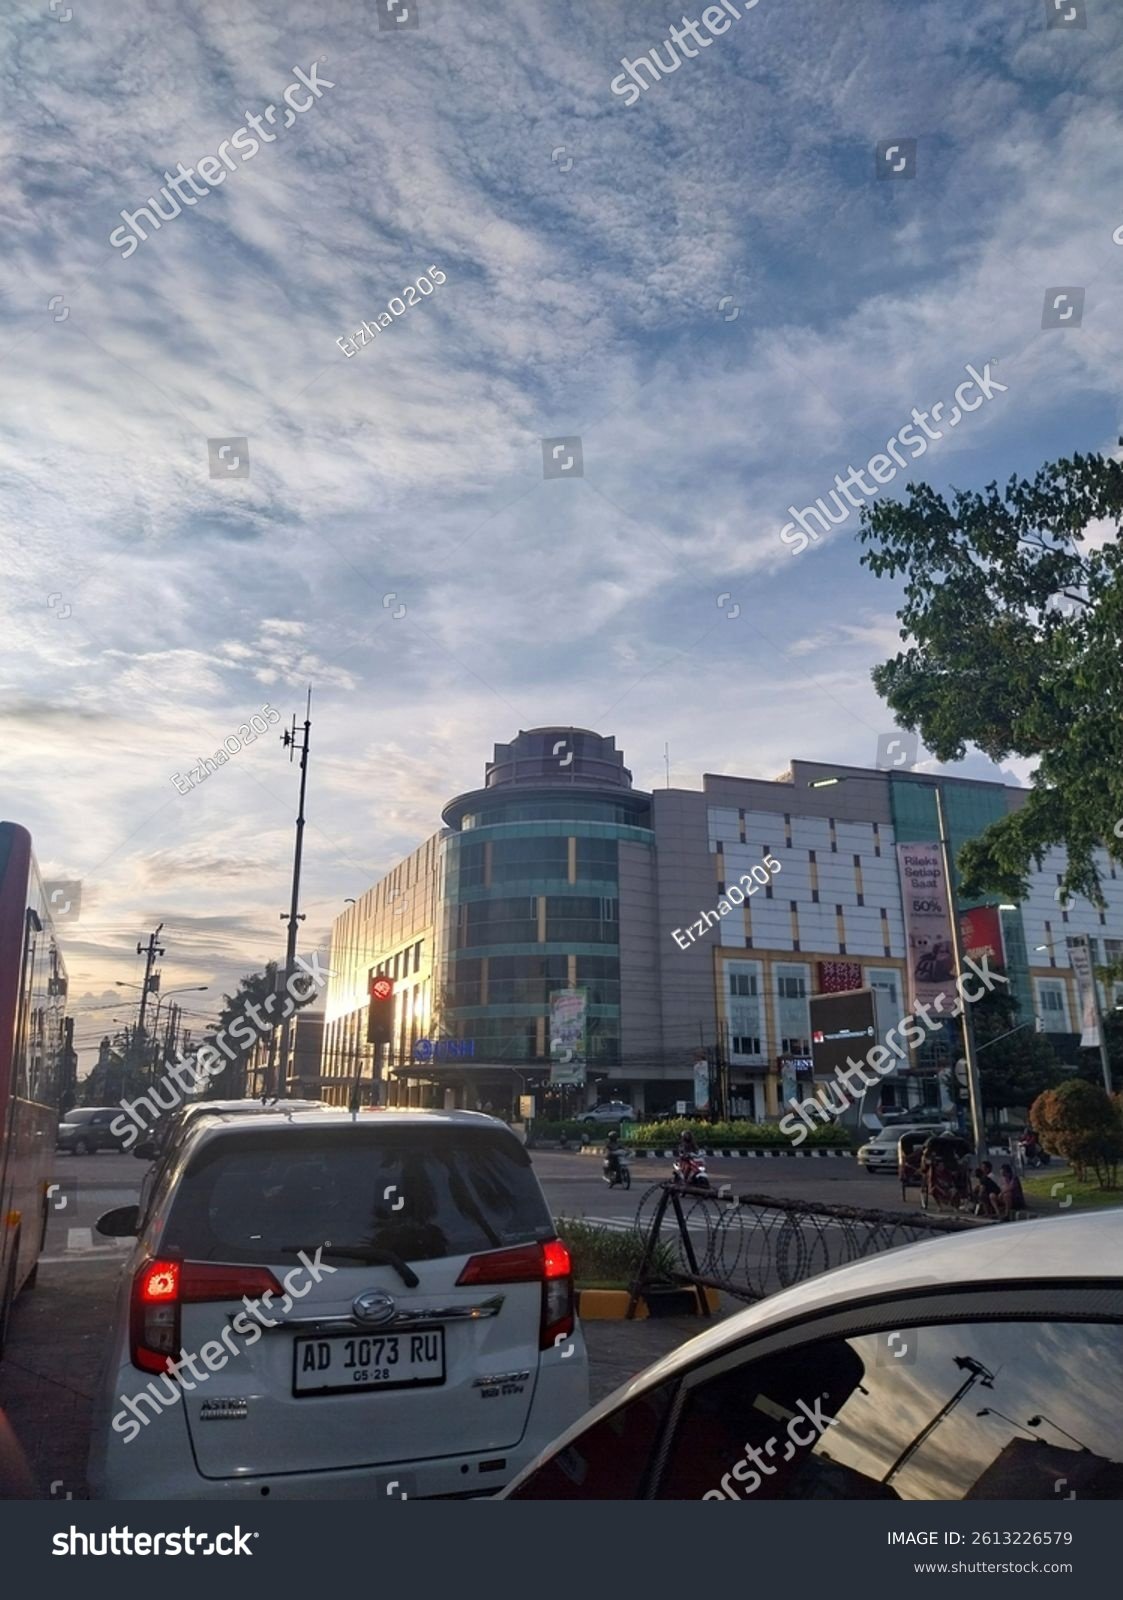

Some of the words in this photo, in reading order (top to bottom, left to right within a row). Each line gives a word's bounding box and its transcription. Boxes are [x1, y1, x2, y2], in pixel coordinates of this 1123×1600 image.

[904, 856, 938, 866] Rileks
[904, 867, 941, 878] Setiap
[911, 879, 938, 888] Saat
[913, 901, 942, 912] 50%
[303, 1342, 331, 1372] AD
[344, 1337, 399, 1368] 1073
[410, 1335, 437, 1362] RU
